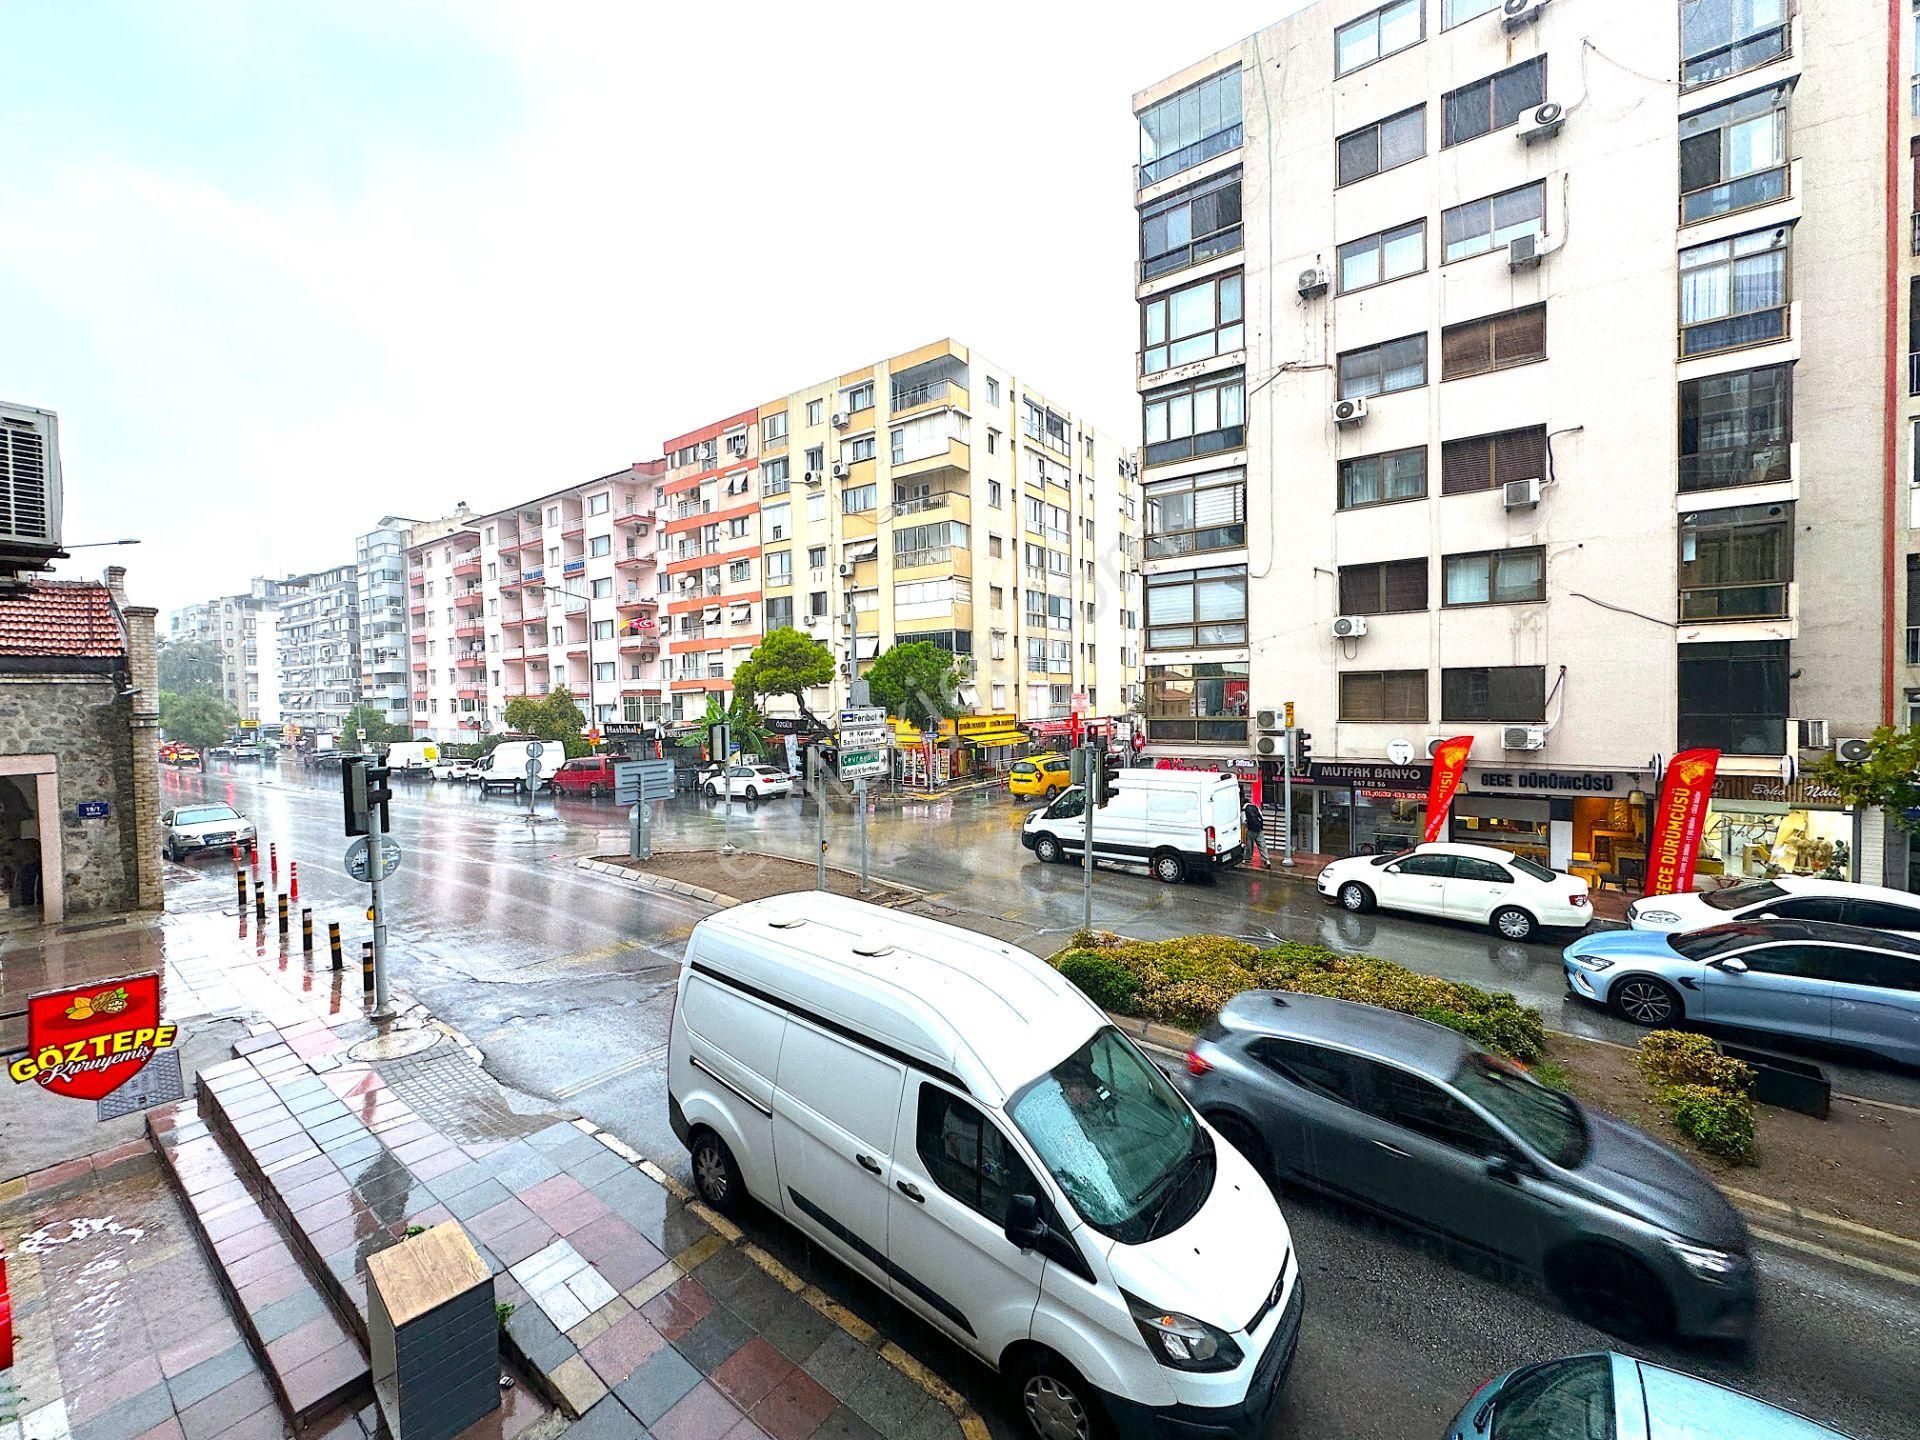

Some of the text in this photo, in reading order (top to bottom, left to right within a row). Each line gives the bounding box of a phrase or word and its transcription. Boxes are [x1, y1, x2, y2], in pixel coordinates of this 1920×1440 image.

[853, 713, 877, 722] Feribot
[1321, 766, 1371, 778] MUTFAK
[1374, 767, 1421, 780] BANYO
[1481, 772, 1613, 792] GECE DÜRÜMCÜSÜ
[1658, 787, 1691, 864] DÜRÜMCÜSÜ
[10, 1026, 177, 1082] GÖZTEPE
[39, 1045, 153, 1085] Kuruyemiş
